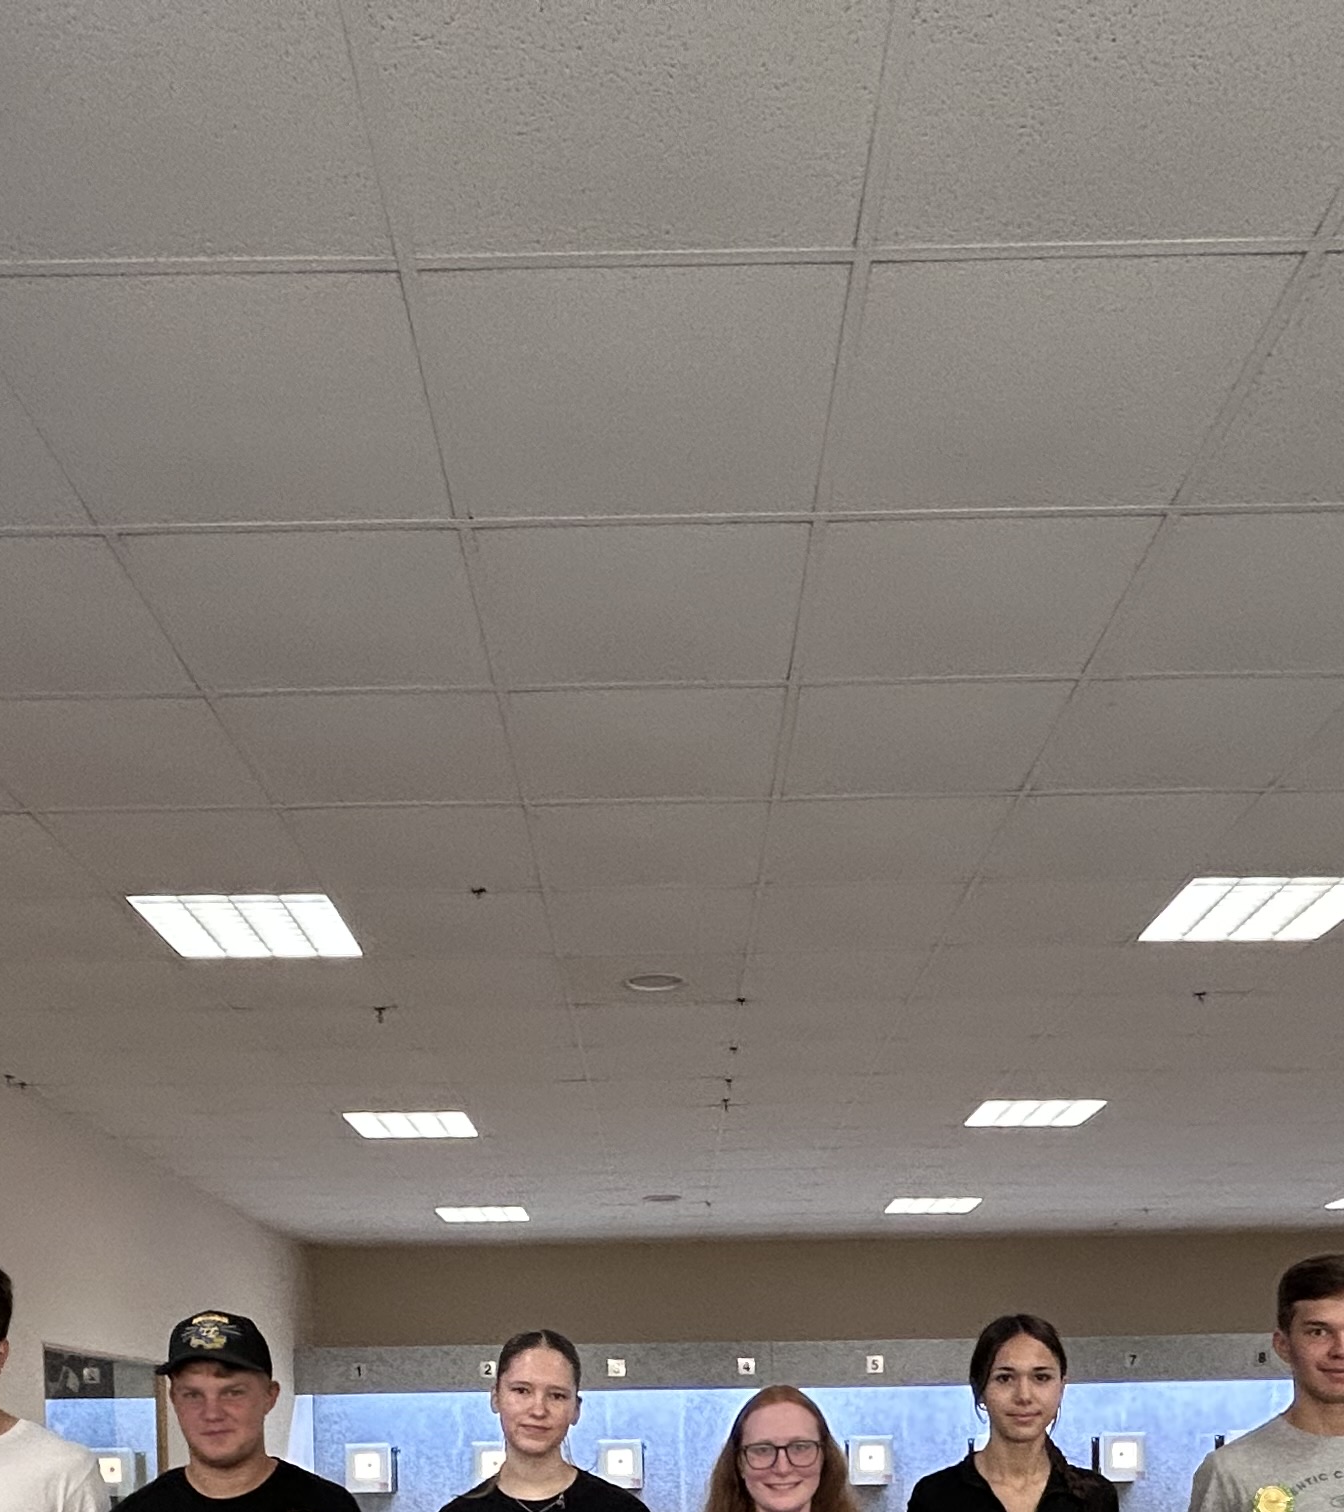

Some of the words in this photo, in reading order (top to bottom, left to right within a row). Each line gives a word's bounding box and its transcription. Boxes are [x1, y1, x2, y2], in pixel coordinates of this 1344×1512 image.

[1129, 1354, 1137, 1367] 7
[1258, 1351, 1267, 1364] 8
[355, 1364, 362, 1377] 1
[484, 1363, 492, 1376] 2
[742, 1360, 752, 1373] 4
[870, 1358, 879, 1371] 5
